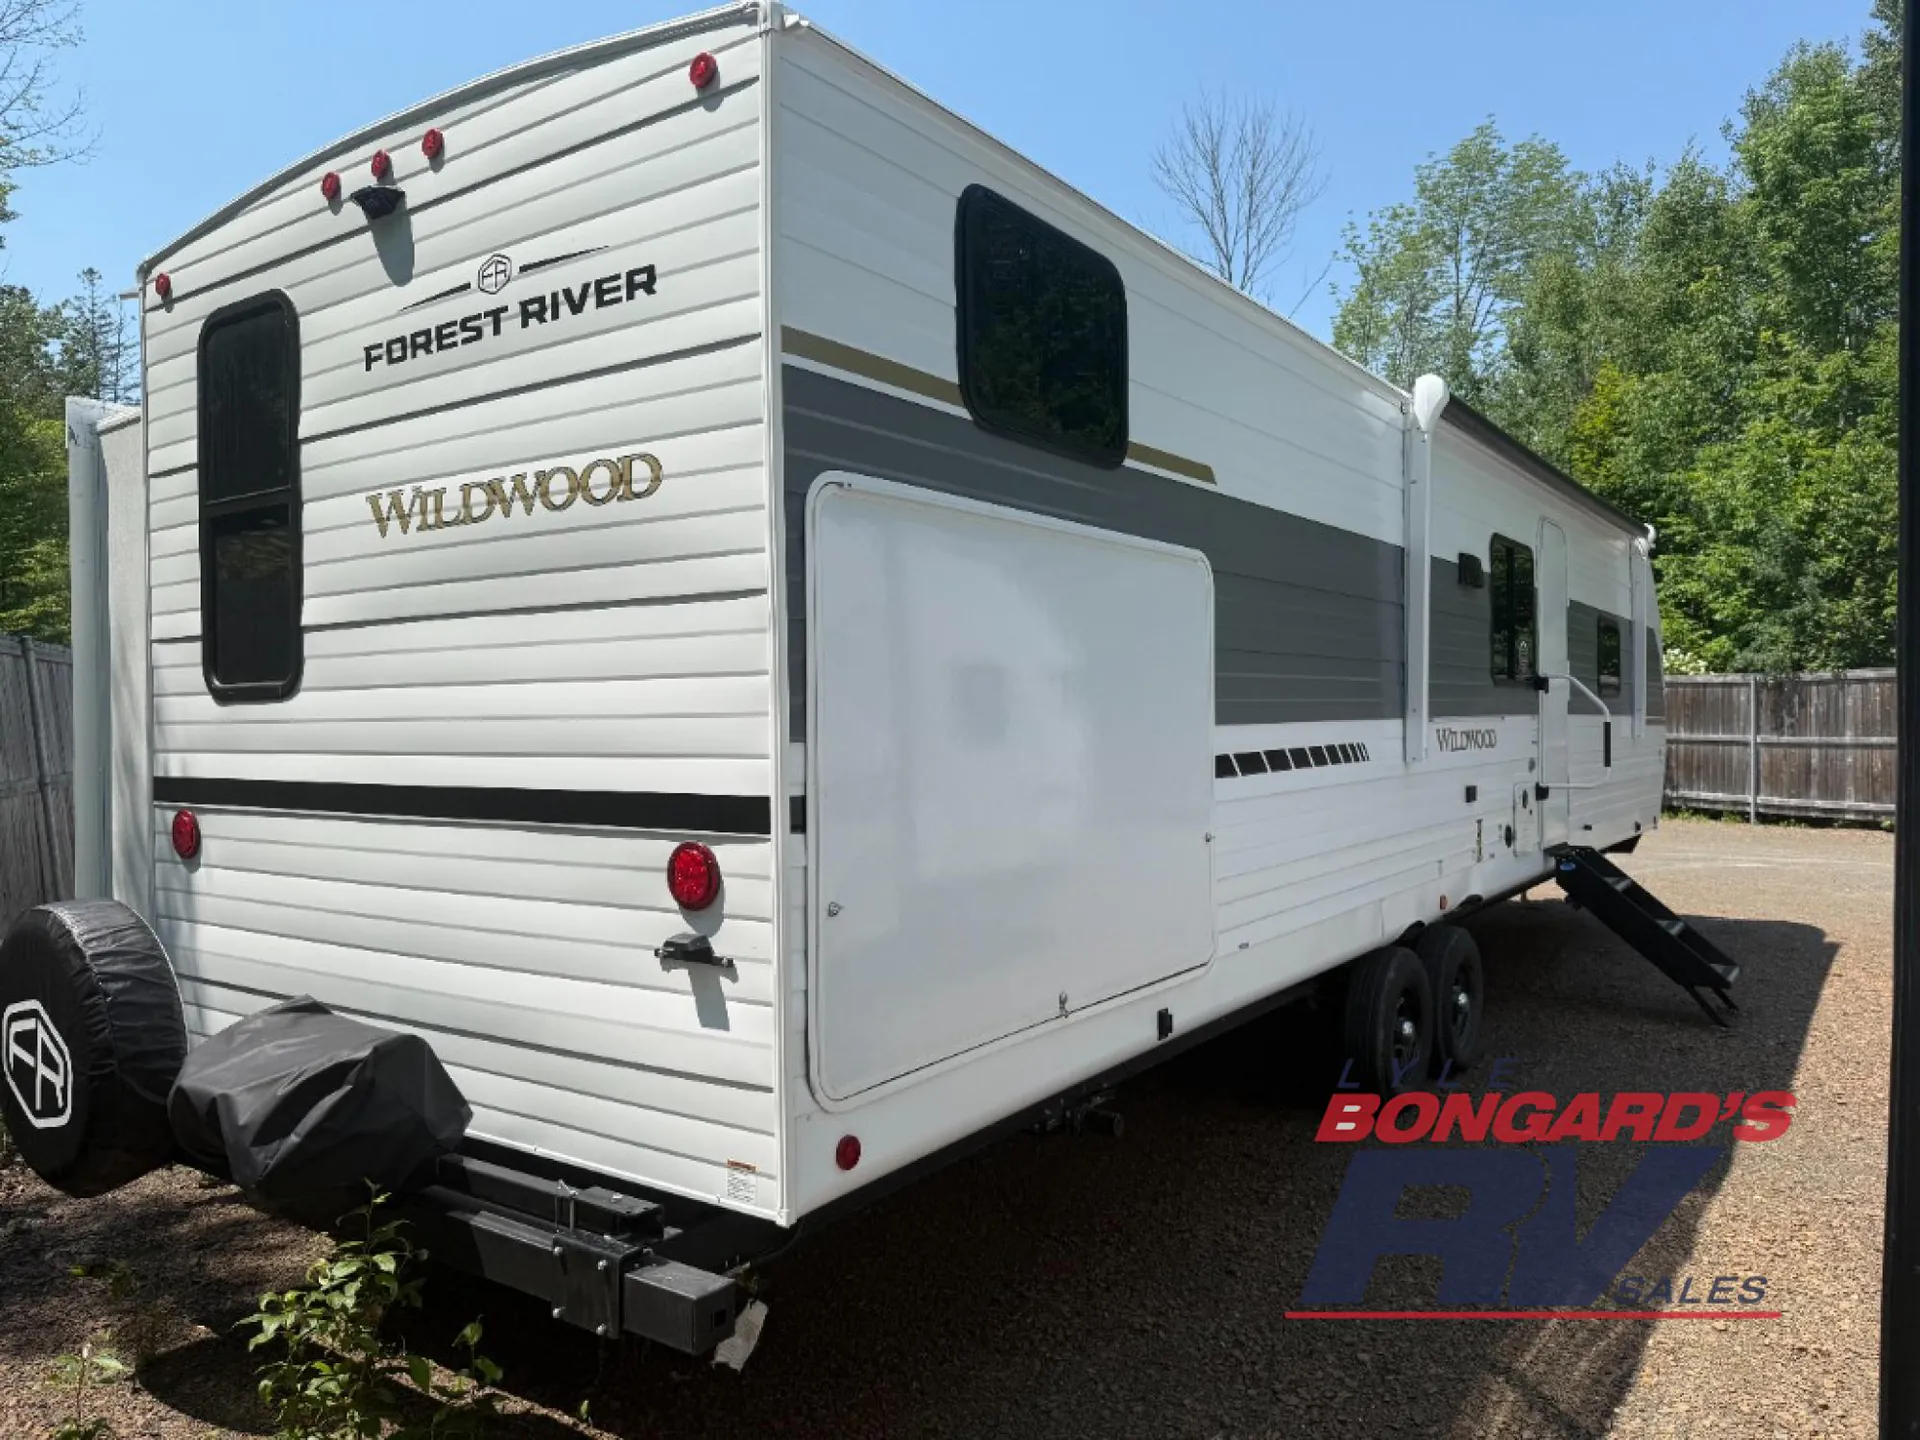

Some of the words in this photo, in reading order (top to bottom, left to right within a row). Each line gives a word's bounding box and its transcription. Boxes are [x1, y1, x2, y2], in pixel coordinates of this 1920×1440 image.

[363, 305, 509, 372] FOREST
[518, 264, 657, 329] RIVER
[365, 452, 663, 538] WILDWOOD
[1435, 728, 1497, 752] WILDWOOD
